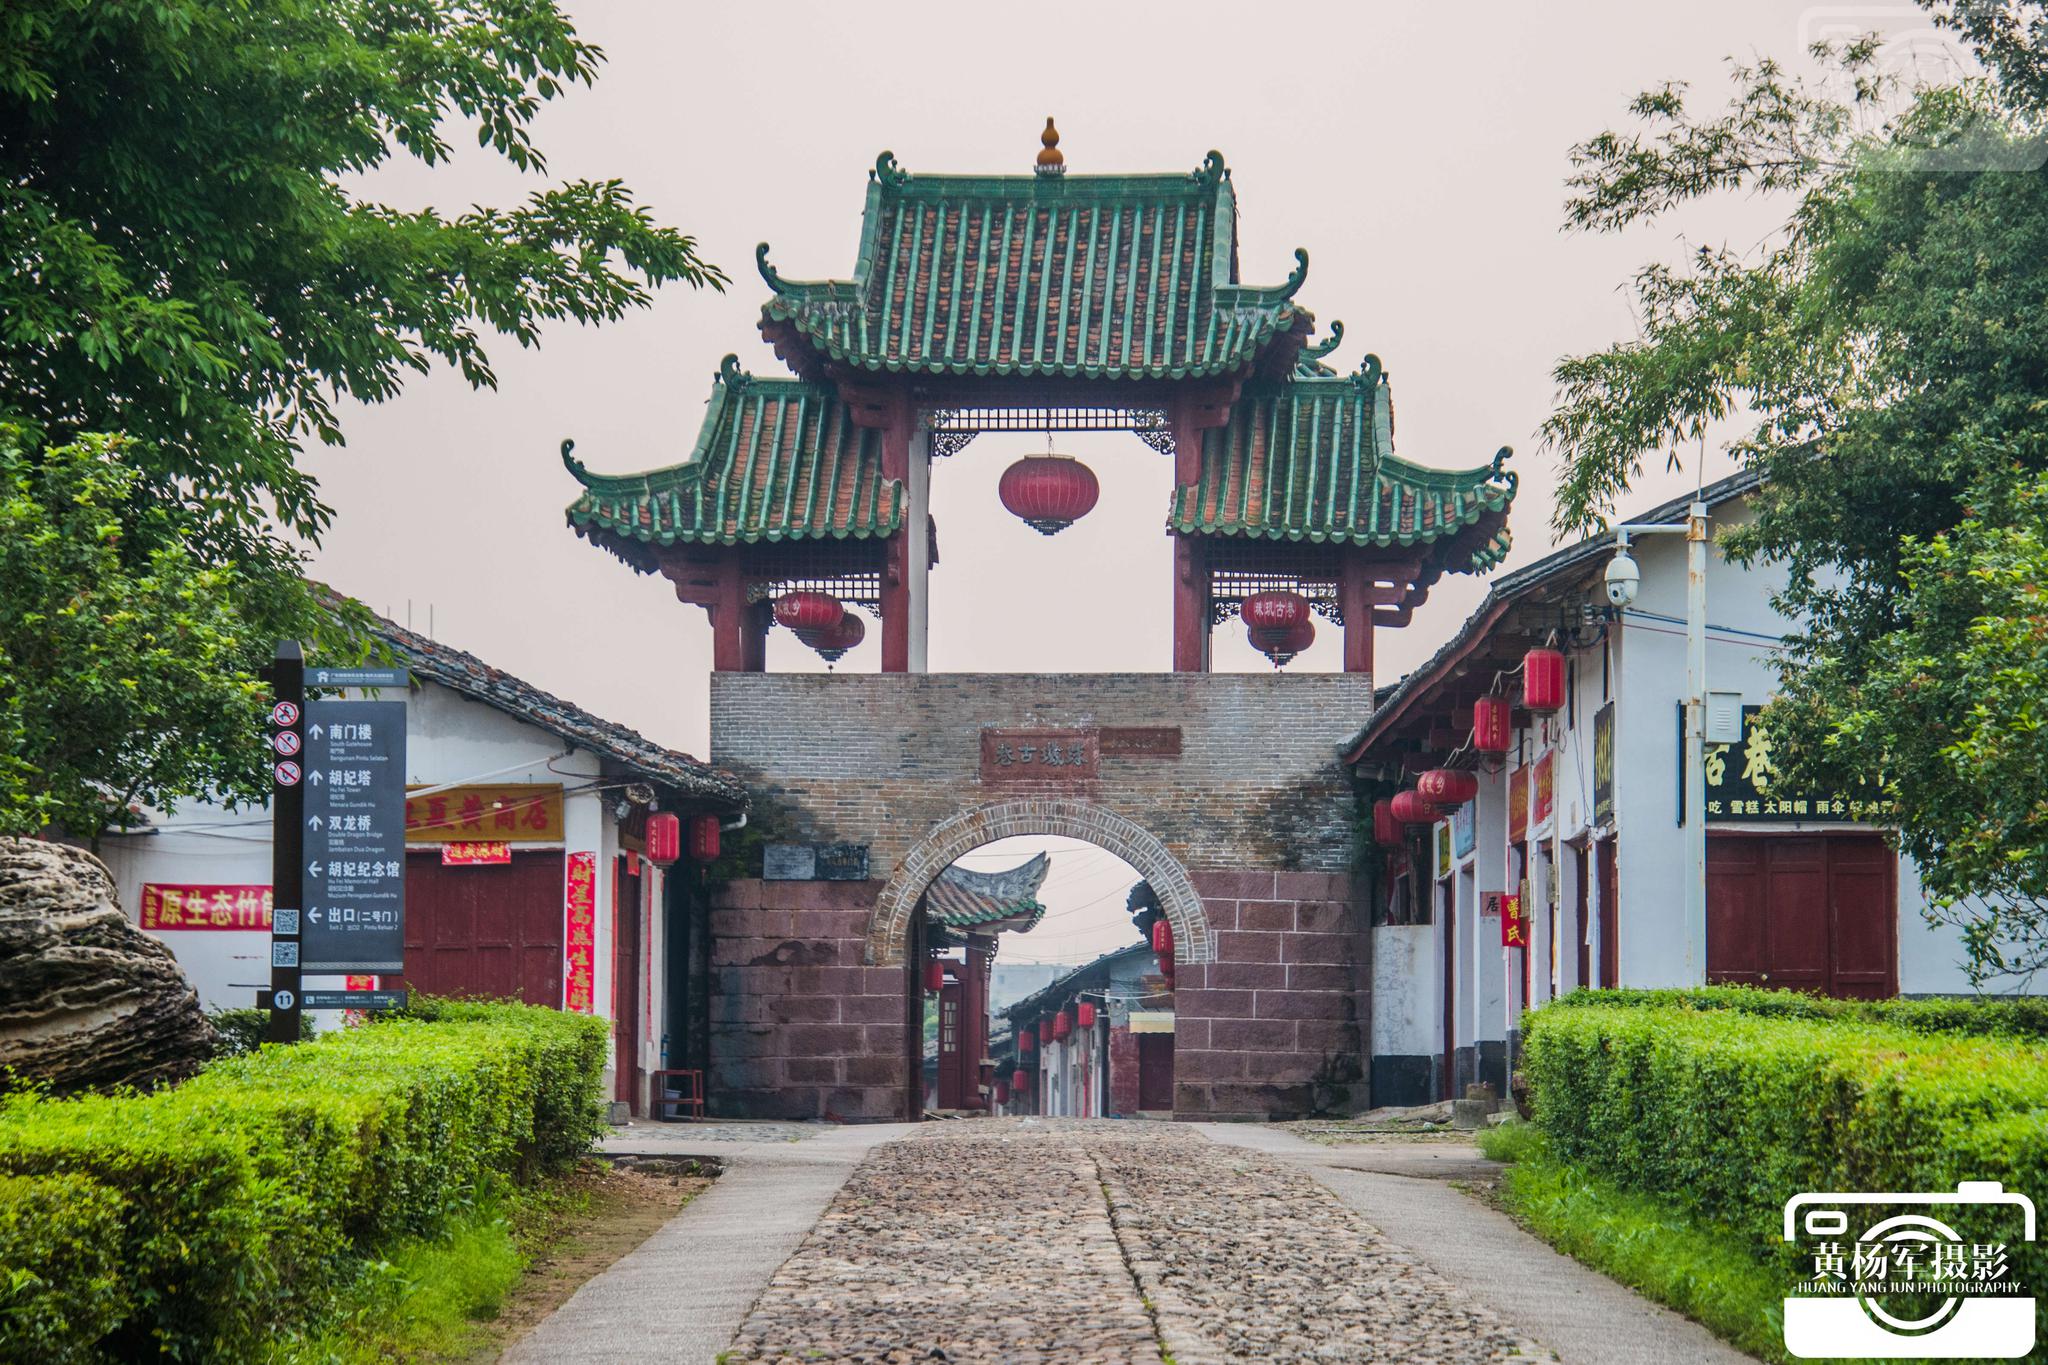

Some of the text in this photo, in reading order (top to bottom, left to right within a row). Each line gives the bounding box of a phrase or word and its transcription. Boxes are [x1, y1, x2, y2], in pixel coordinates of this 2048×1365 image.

[329, 724, 372, 740] 南门楼
[329, 770, 371, 786] 胡妃塔
[1731, 800, 1759, 814] 雪糕
[1764, 800, 1807, 814] 太阳帽
[1816, 800, 1844, 814] 雨伞
[328, 815, 371, 830] 双龙桥
[328, 861, 400, 877] 胡妃纪念馆
[1486, 896, 1500, 912] 居
[1506, 897, 1525, 945] 曾氏
[278, 995, 291, 1005] 11
